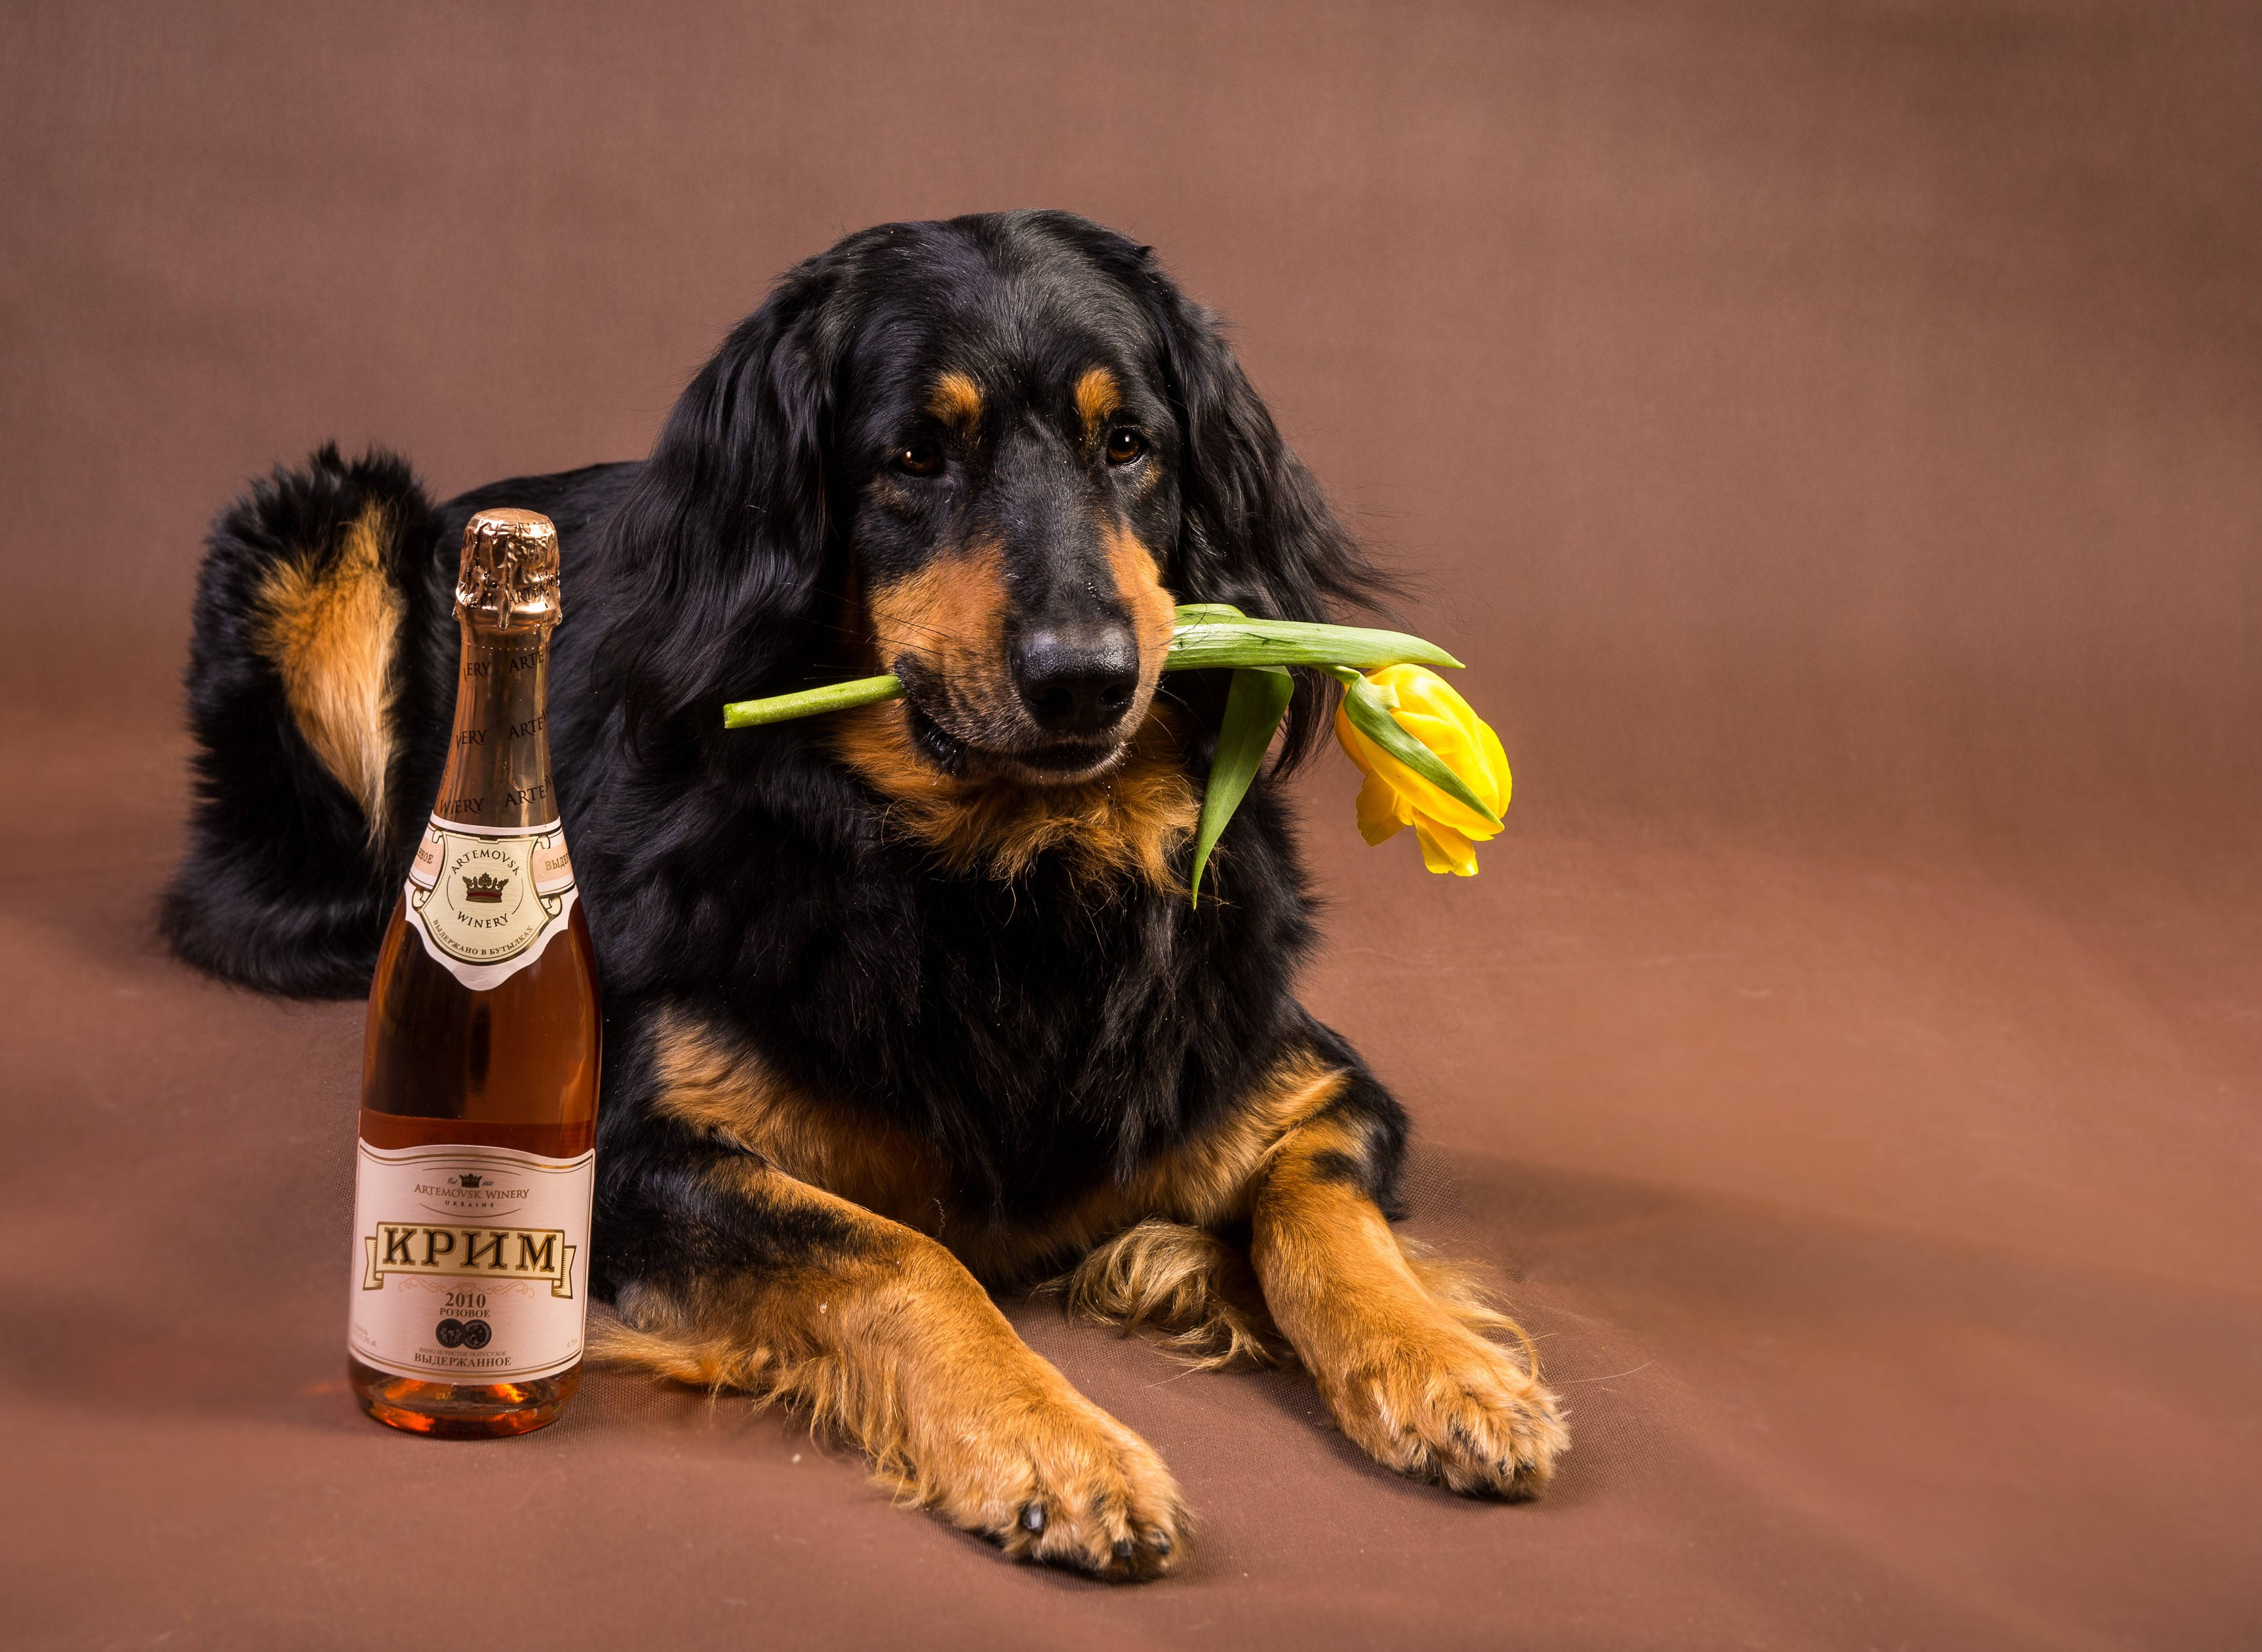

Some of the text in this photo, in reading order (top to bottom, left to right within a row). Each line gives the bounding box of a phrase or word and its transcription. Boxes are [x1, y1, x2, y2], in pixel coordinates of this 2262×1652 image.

[451, 849, 521, 876] ARTEMOVSK
[457, 911, 509, 928] WINERY
[433, 919, 478, 954] ВЫДЕРЖАНО
[490, 925, 533, 955] БУТЫЛКАХ
[414, 1184, 530, 1199] ARTEMOVSK WINERY
[382, 1227, 558, 1272] КРИМ
[445, 1292, 486, 1308] 2010
[439, 1308, 490, 1318] РОЗОВОЕ
[414, 1353, 511, 1367] ВЫДЕРЖАННОЕ
